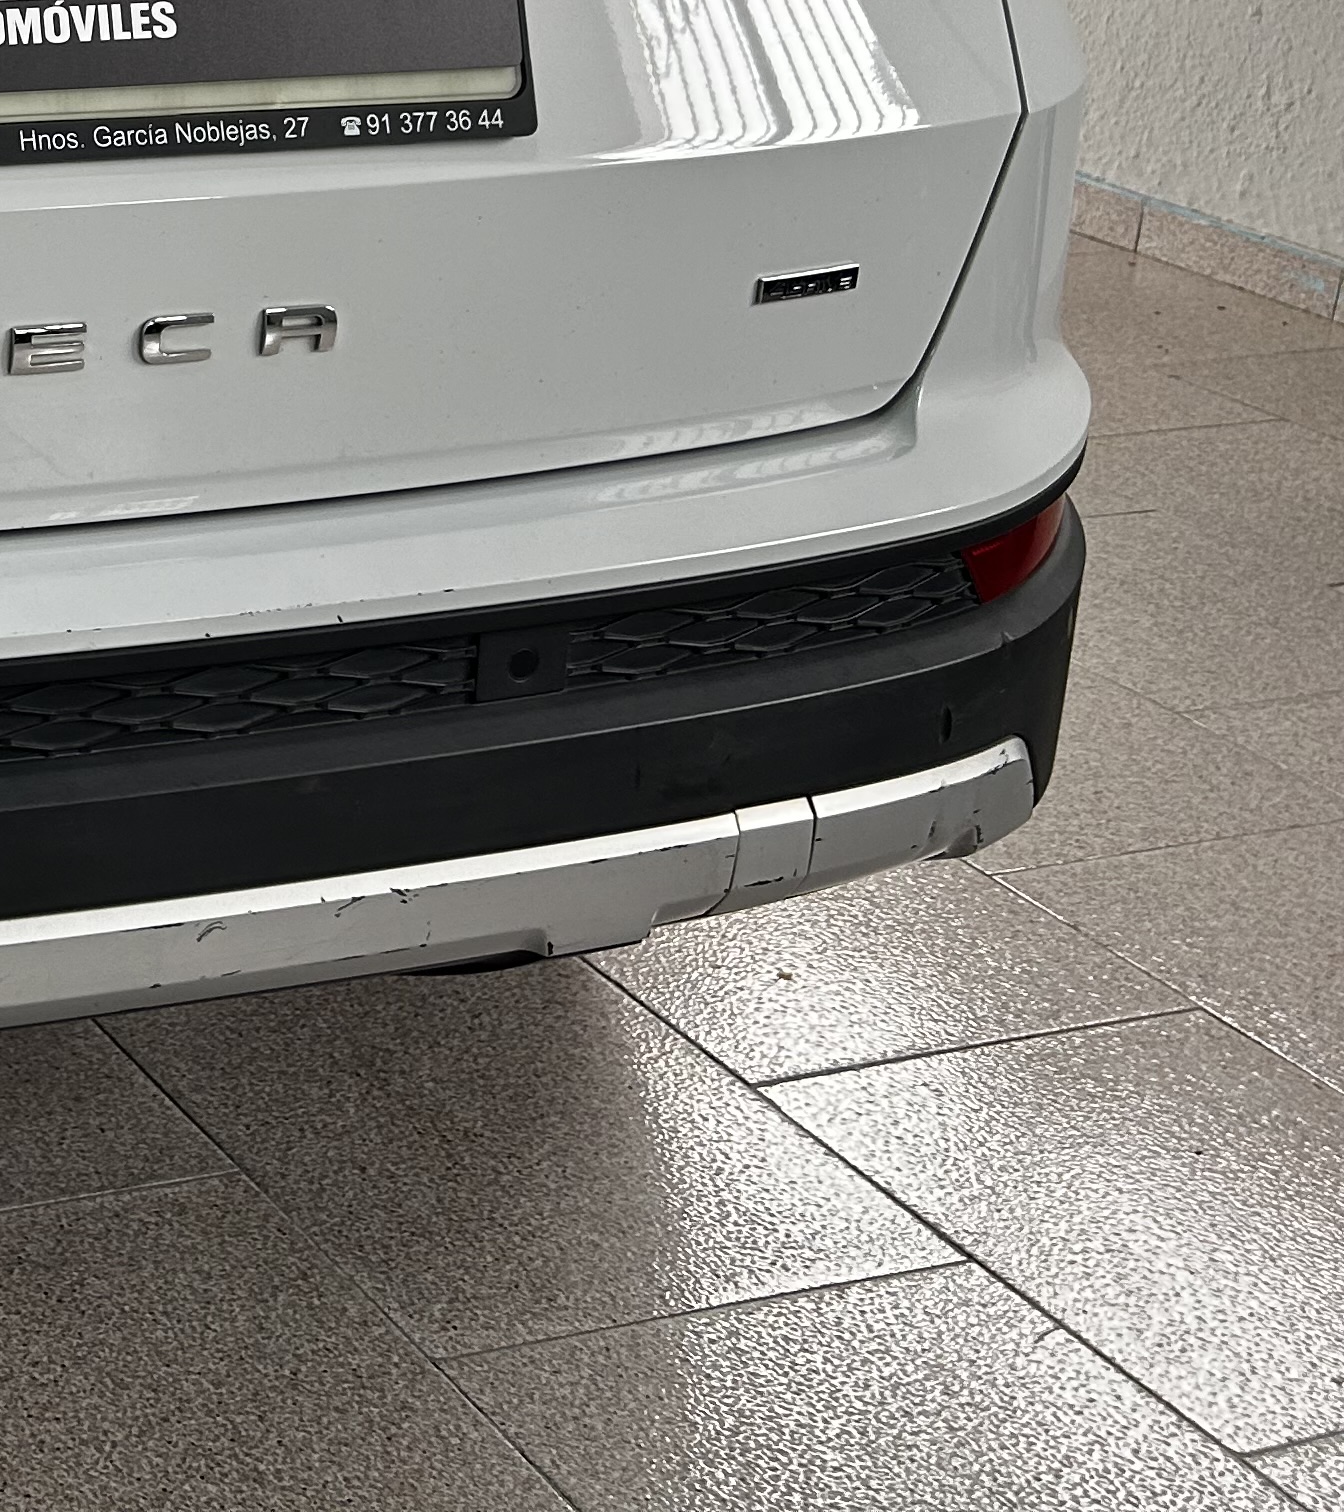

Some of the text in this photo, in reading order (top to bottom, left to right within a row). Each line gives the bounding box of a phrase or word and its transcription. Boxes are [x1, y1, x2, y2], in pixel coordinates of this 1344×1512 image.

[19, 116, 309, 151] Hnos. García Noblejas, 27
[367, 108, 504, 135] 91 377 36 44
